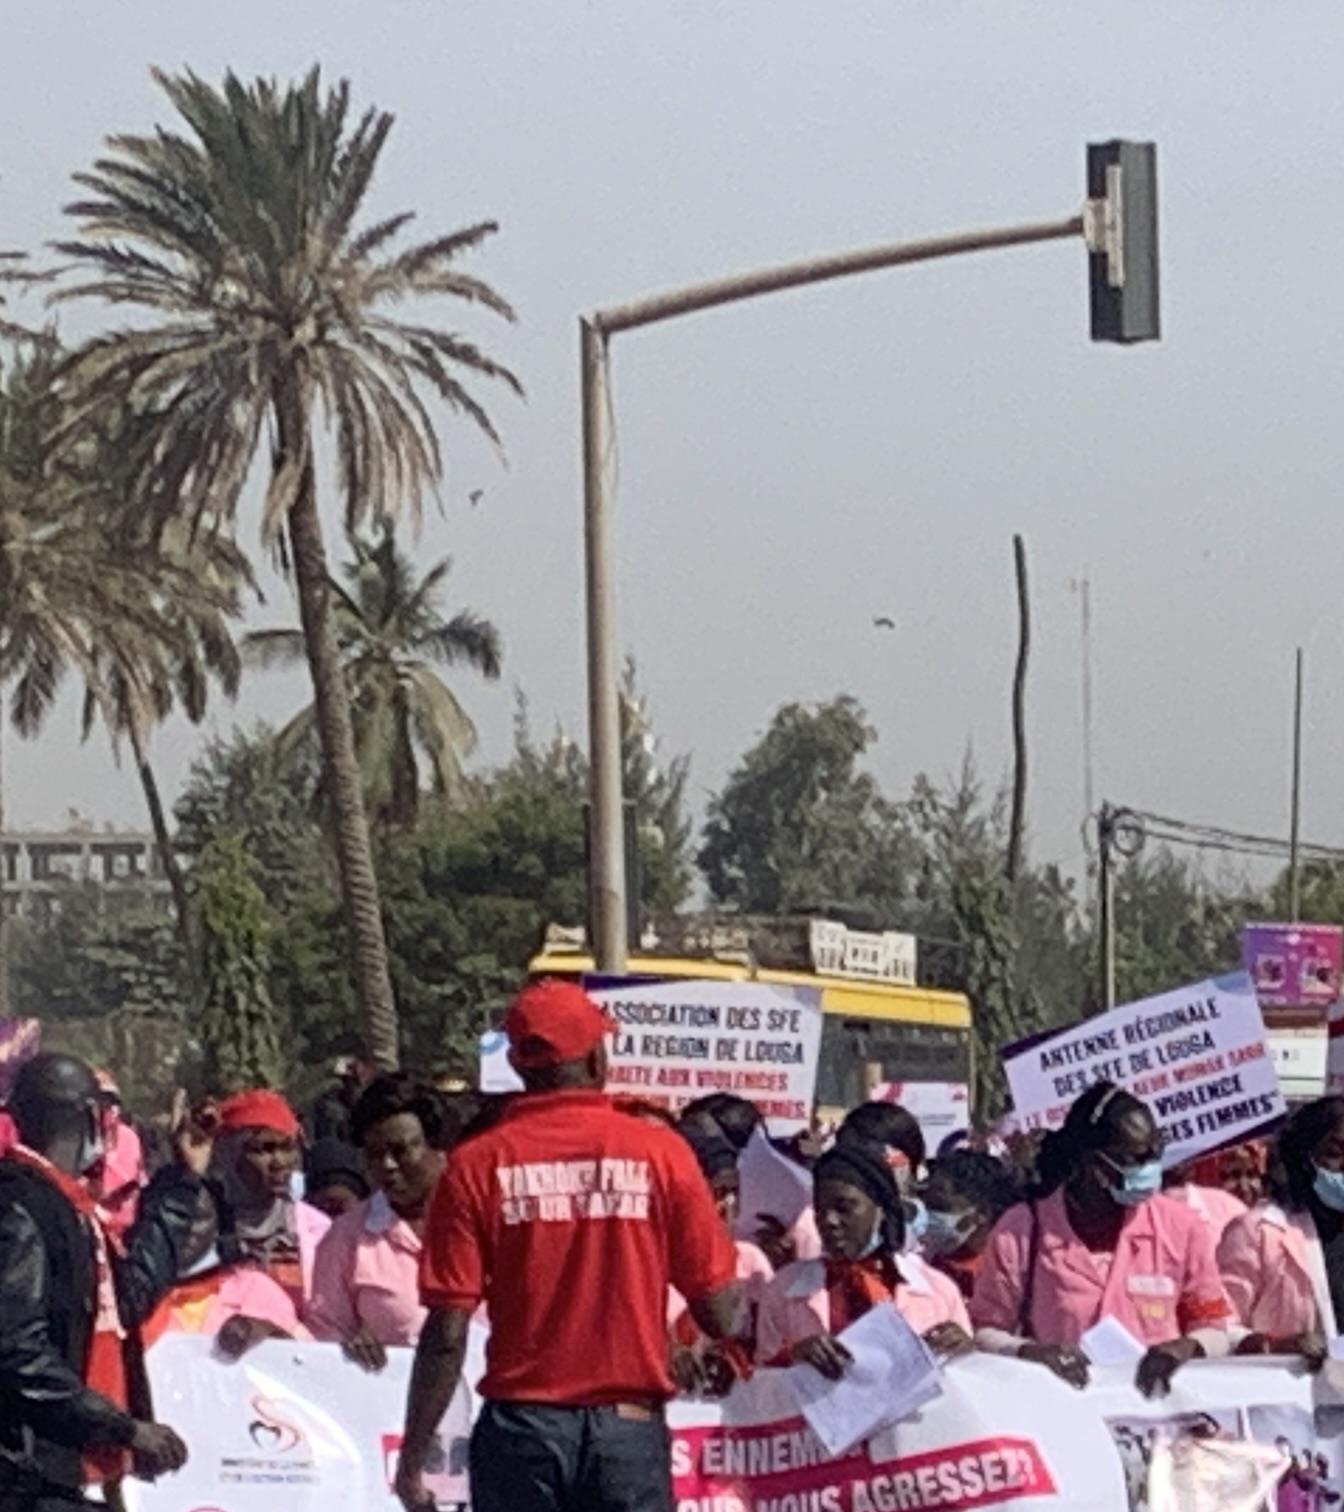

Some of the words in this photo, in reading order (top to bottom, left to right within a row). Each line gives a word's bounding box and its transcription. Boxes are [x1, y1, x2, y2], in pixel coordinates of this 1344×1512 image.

[725, 1006, 762, 1031] DES
[767, 1008, 801, 1033] SFE
[612, 1034, 636, 1057] LA
[716, 1037, 738, 1061] DE
[744, 1040, 805, 1064] LOUGA
[1039, 1028, 1121, 1074] ANTENNE
[1123, 996, 1222, 1045] RÉGIONALE
[1130, 1050, 1156, 1074] DE
